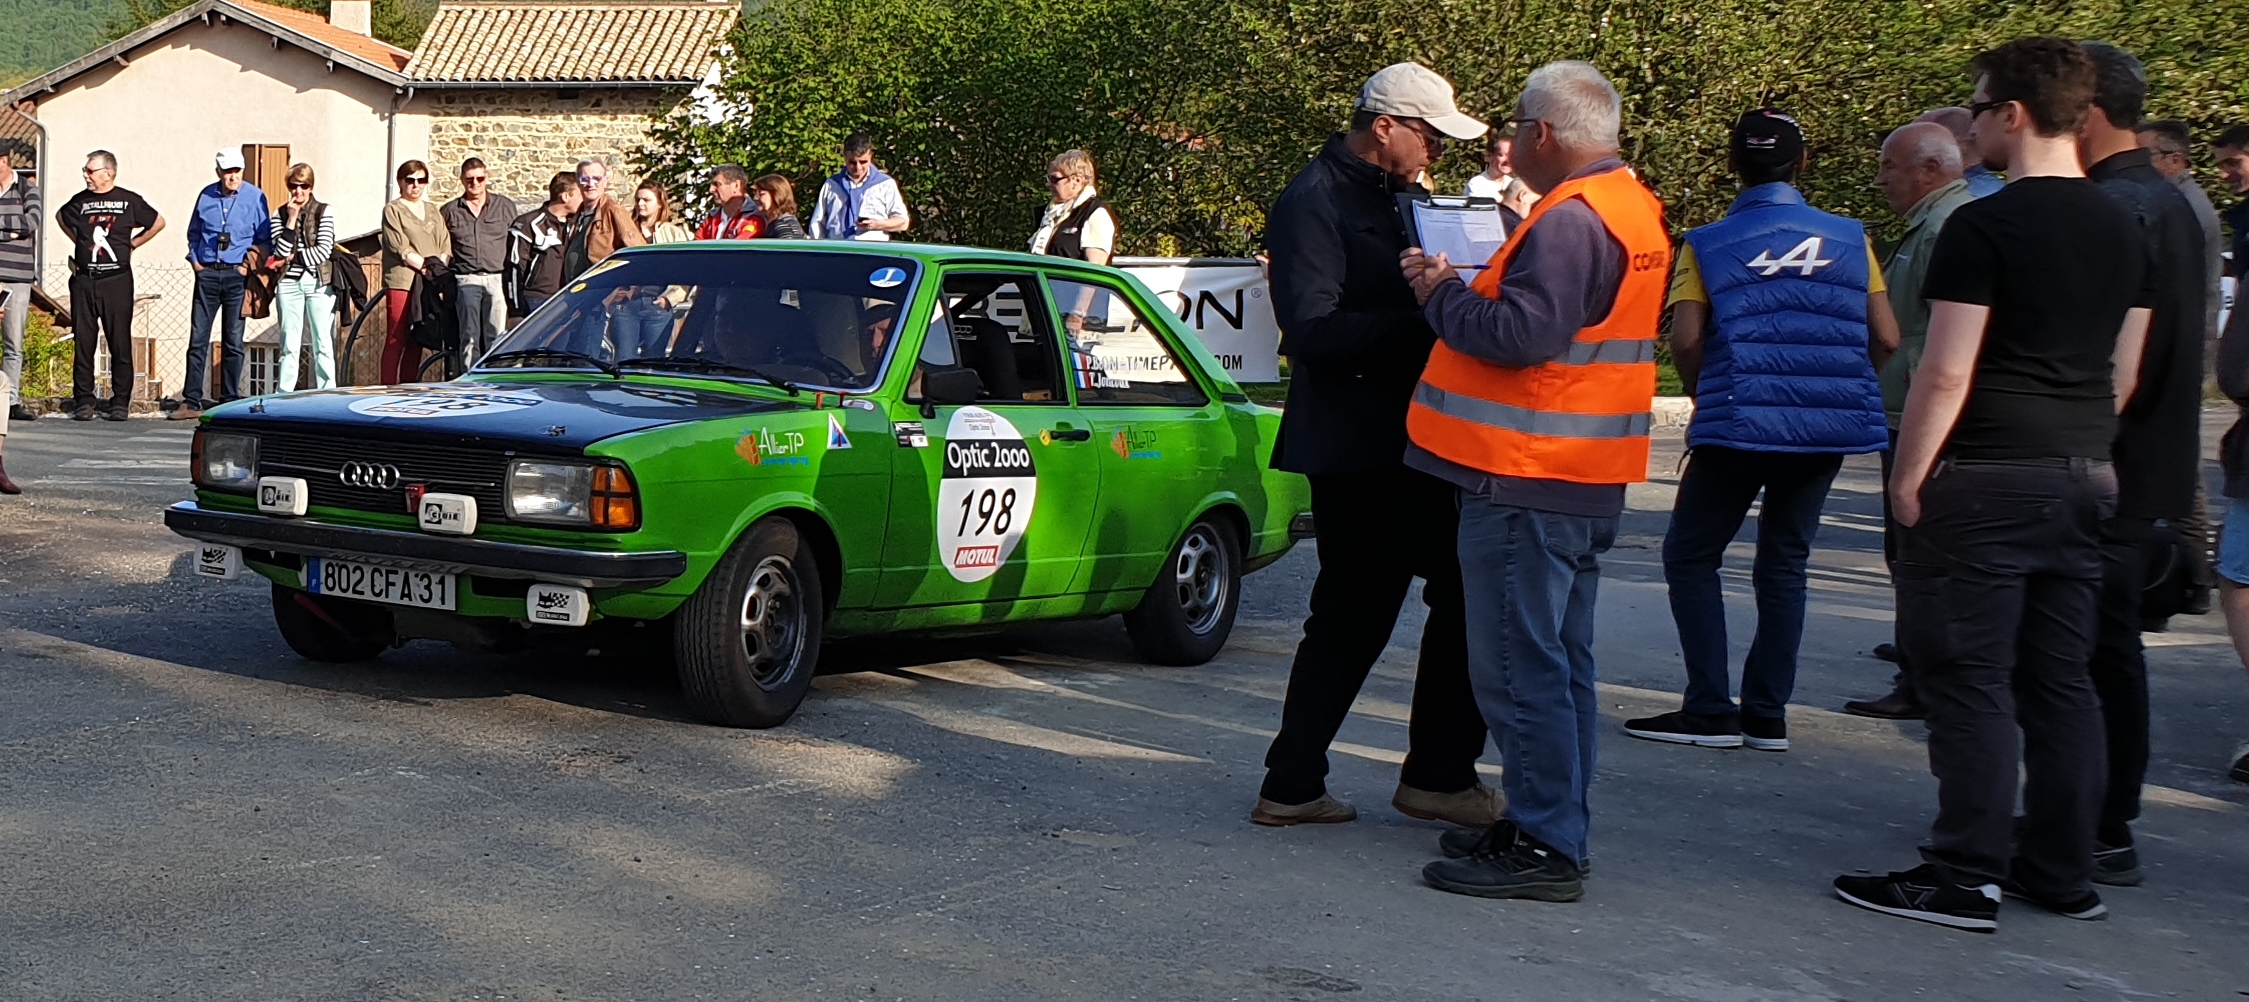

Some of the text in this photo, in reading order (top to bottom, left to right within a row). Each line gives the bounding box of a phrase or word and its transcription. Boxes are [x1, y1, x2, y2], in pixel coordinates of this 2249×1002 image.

[947, 441, 1030, 477] Optic 2000
[957, 487, 1016, 538] 198
[958, 549, 996, 565] MOTUL
[324, 561, 365, 596] 802
[370, 566, 413, 602] CFA
[418, 572, 446, 606] 31
